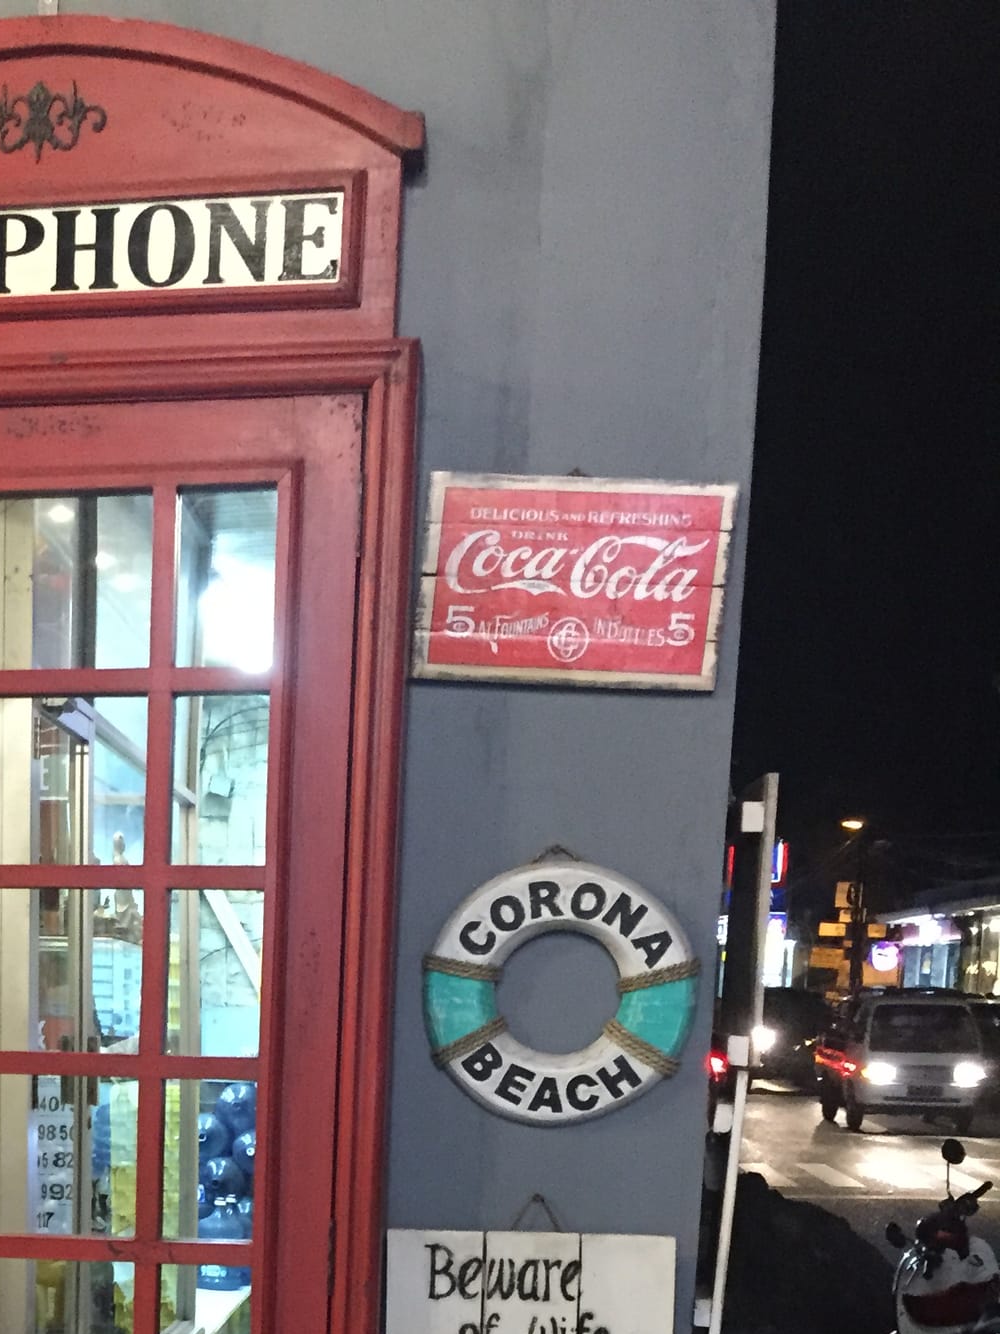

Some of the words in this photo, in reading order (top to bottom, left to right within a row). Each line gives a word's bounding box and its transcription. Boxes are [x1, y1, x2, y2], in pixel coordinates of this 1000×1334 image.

[470, 507, 560, 522] DELICIOUS
[561, 513, 586, 523] AND
[587, 511, 693, 527] REFRESHING
[511, 530, 569, 542] DRINK
[594, 617, 606, 636] IN
[459, 880, 673, 969] CORONA
[461, 1042, 643, 1113] BEACH
[425, 1243, 582, 1302] Beware
